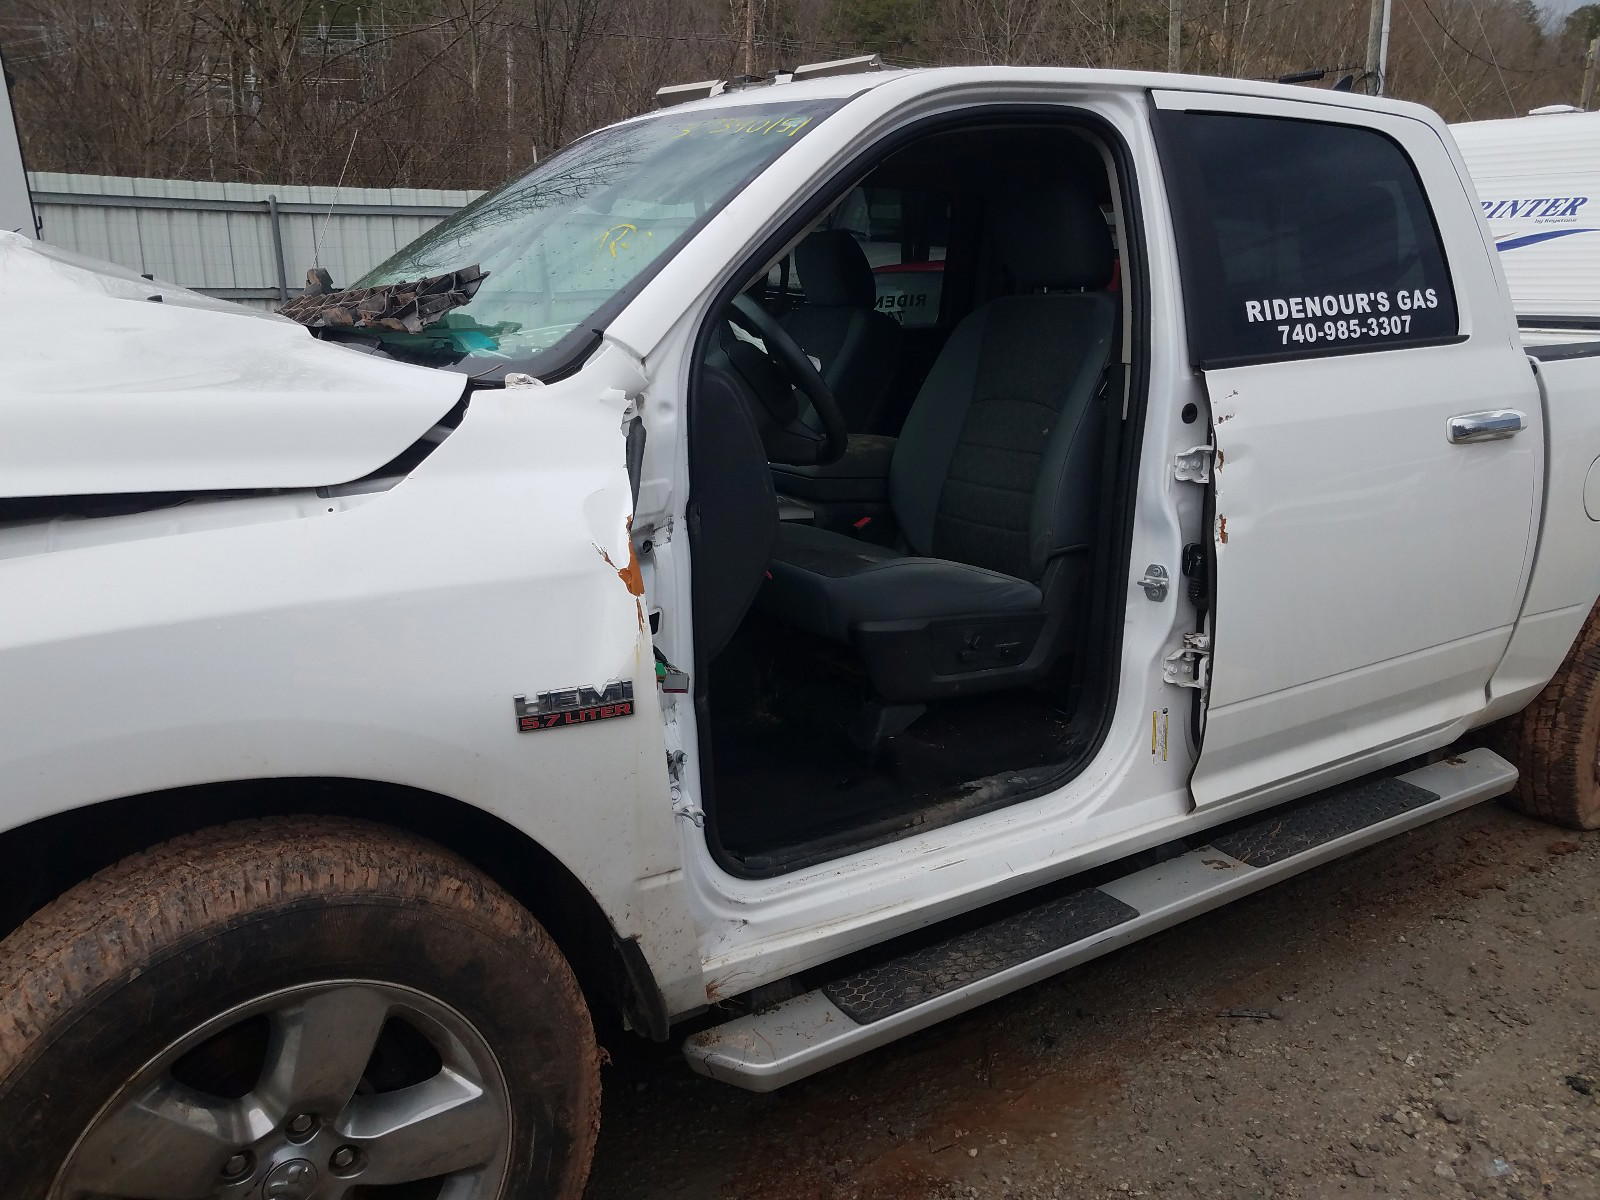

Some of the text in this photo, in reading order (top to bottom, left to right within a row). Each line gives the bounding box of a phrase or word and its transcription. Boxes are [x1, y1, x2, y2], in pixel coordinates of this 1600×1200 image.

[1245, 288, 1438, 323] RIDENOUR'S GAS
[1277, 315, 1412, 345] 740-985-3307
[513, 677, 634, 717] HEMI
[521, 703, 632, 730] 5.7 LITER
